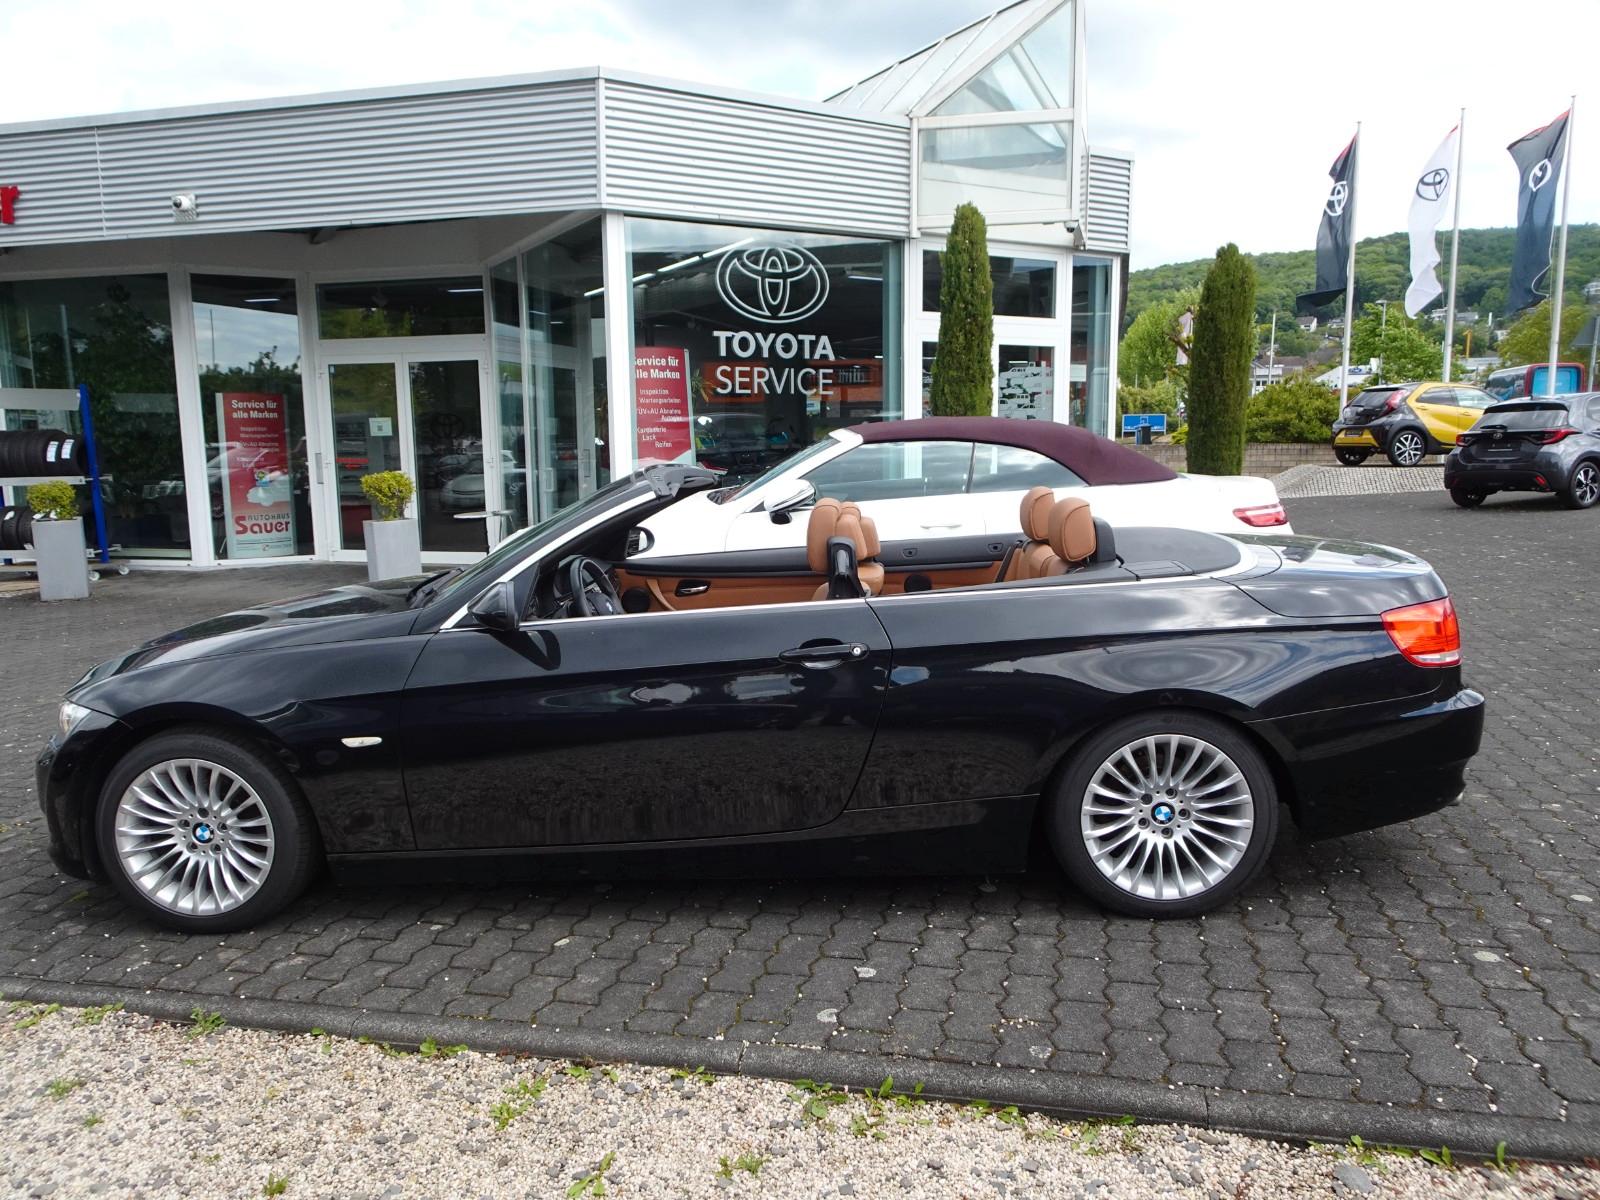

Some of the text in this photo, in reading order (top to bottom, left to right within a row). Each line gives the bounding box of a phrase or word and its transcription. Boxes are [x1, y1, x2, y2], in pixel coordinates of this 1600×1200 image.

[0, 186, 20, 224] r
[712, 330, 836, 361] TOYOTA
[668, 355, 679, 366] für
[636, 369, 680, 379] lle Marken
[716, 365, 834, 396] SERVICE
[231, 399, 277, 409] Service für
[232, 410, 278, 419] alle Marken
[247, 512, 290, 521] AUTOHAUS
[234, 515, 290, 535] Sauer
